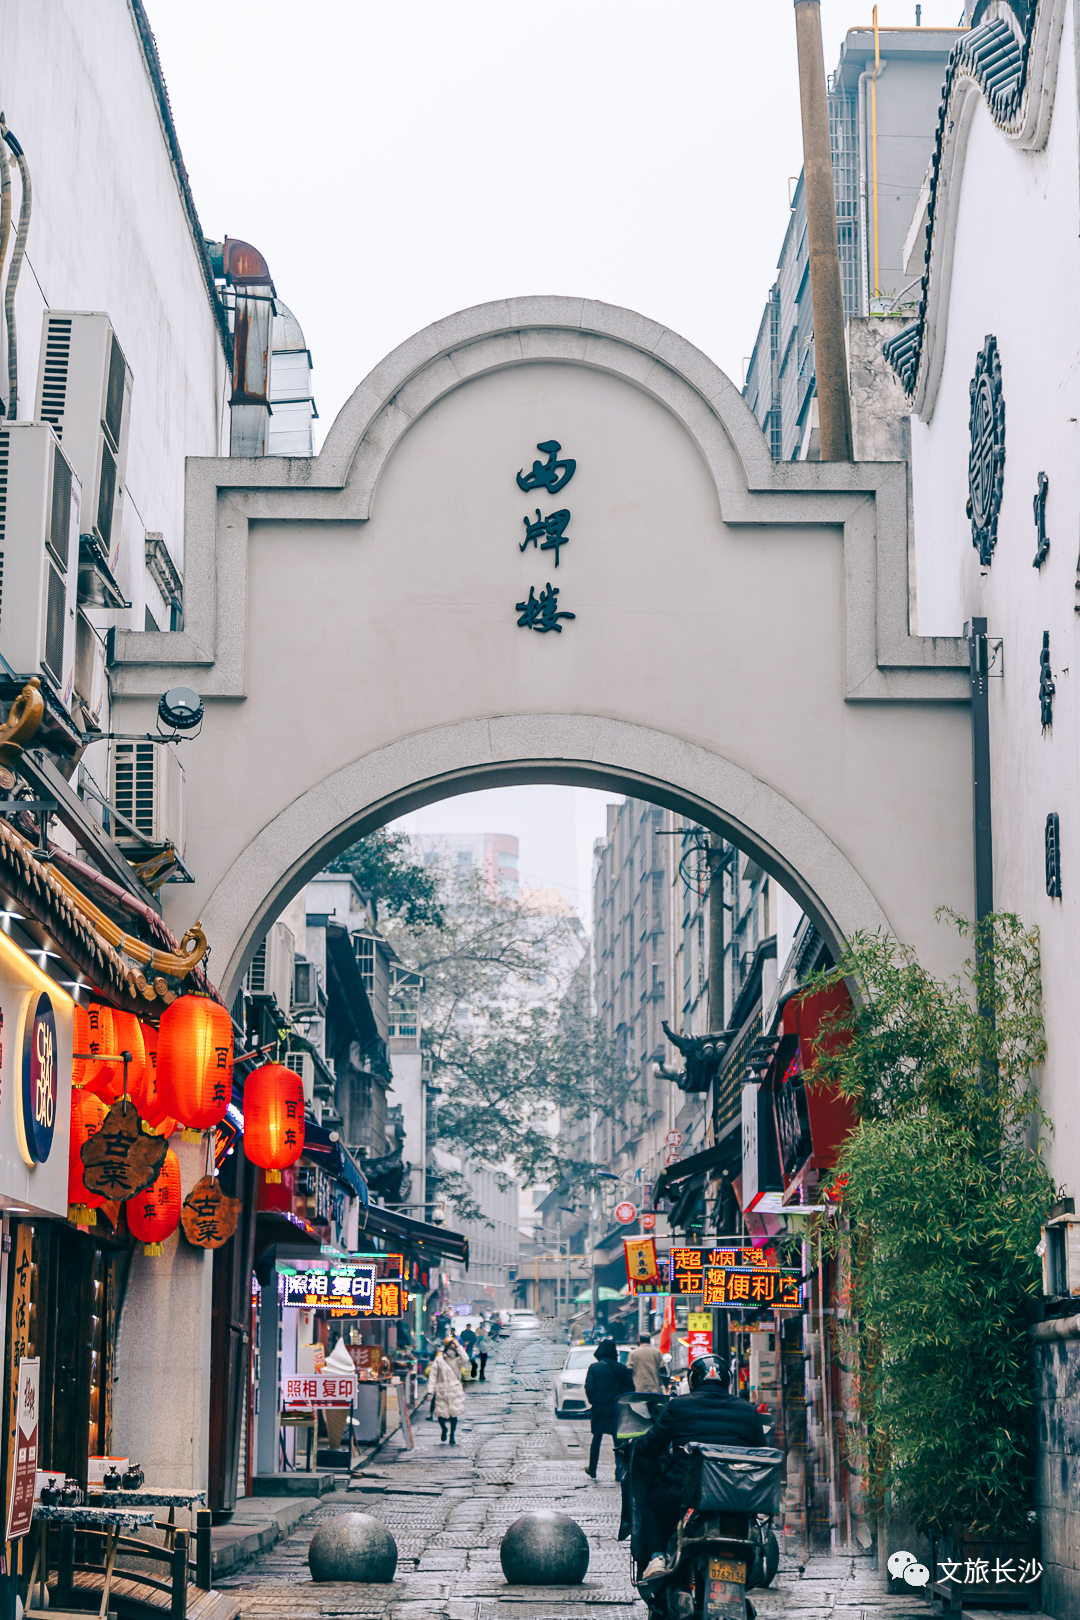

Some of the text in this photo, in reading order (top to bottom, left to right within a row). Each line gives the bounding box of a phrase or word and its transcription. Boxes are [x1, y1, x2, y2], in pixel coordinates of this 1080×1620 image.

[516, 440, 577, 633] 西牌楼
[213, 1047, 229, 1107] 百年
[36, 1079, 53, 1127] DAO
[285, 1101, 298, 1149] 百年
[96, 1130, 137, 1189] 古菜
[194, 1195, 223, 1242] 古菜
[289, 1275, 371, 1297] 照相 复印
[675, 1250, 703, 1293] 超市
[287, 1380, 353, 1398] 照相 复印
